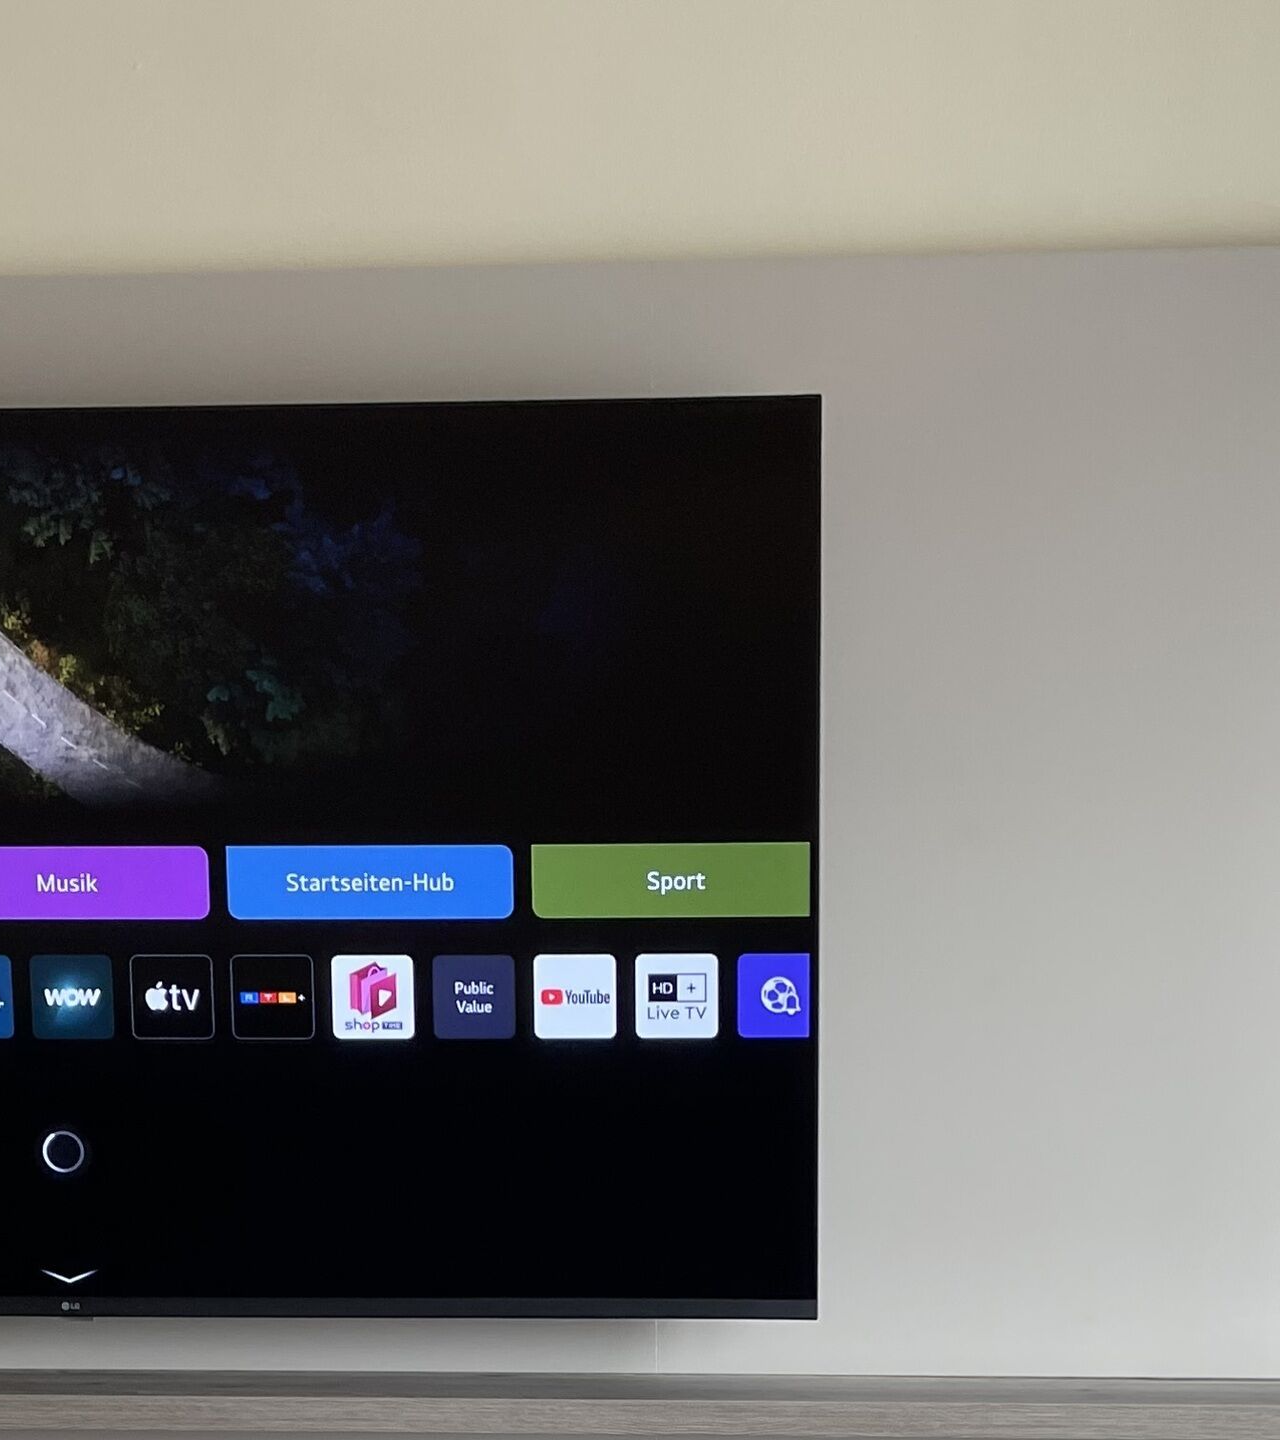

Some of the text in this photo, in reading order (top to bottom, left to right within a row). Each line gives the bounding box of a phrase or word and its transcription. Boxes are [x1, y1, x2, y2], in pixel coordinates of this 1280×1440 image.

[36, 874, 98, 893] Musik
[286, 872, 455, 893] Startseiten-Hub
[646, 871, 706, 895] Sport
[454, 981, 495, 996] Public
[565, 989, 611, 1005] YouTube
[167, 984, 201, 1011] tv
[456, 1000, 493, 1014] Value
[647, 1006, 708, 1020] Live TV
[344, 1017, 381, 1034] shop
